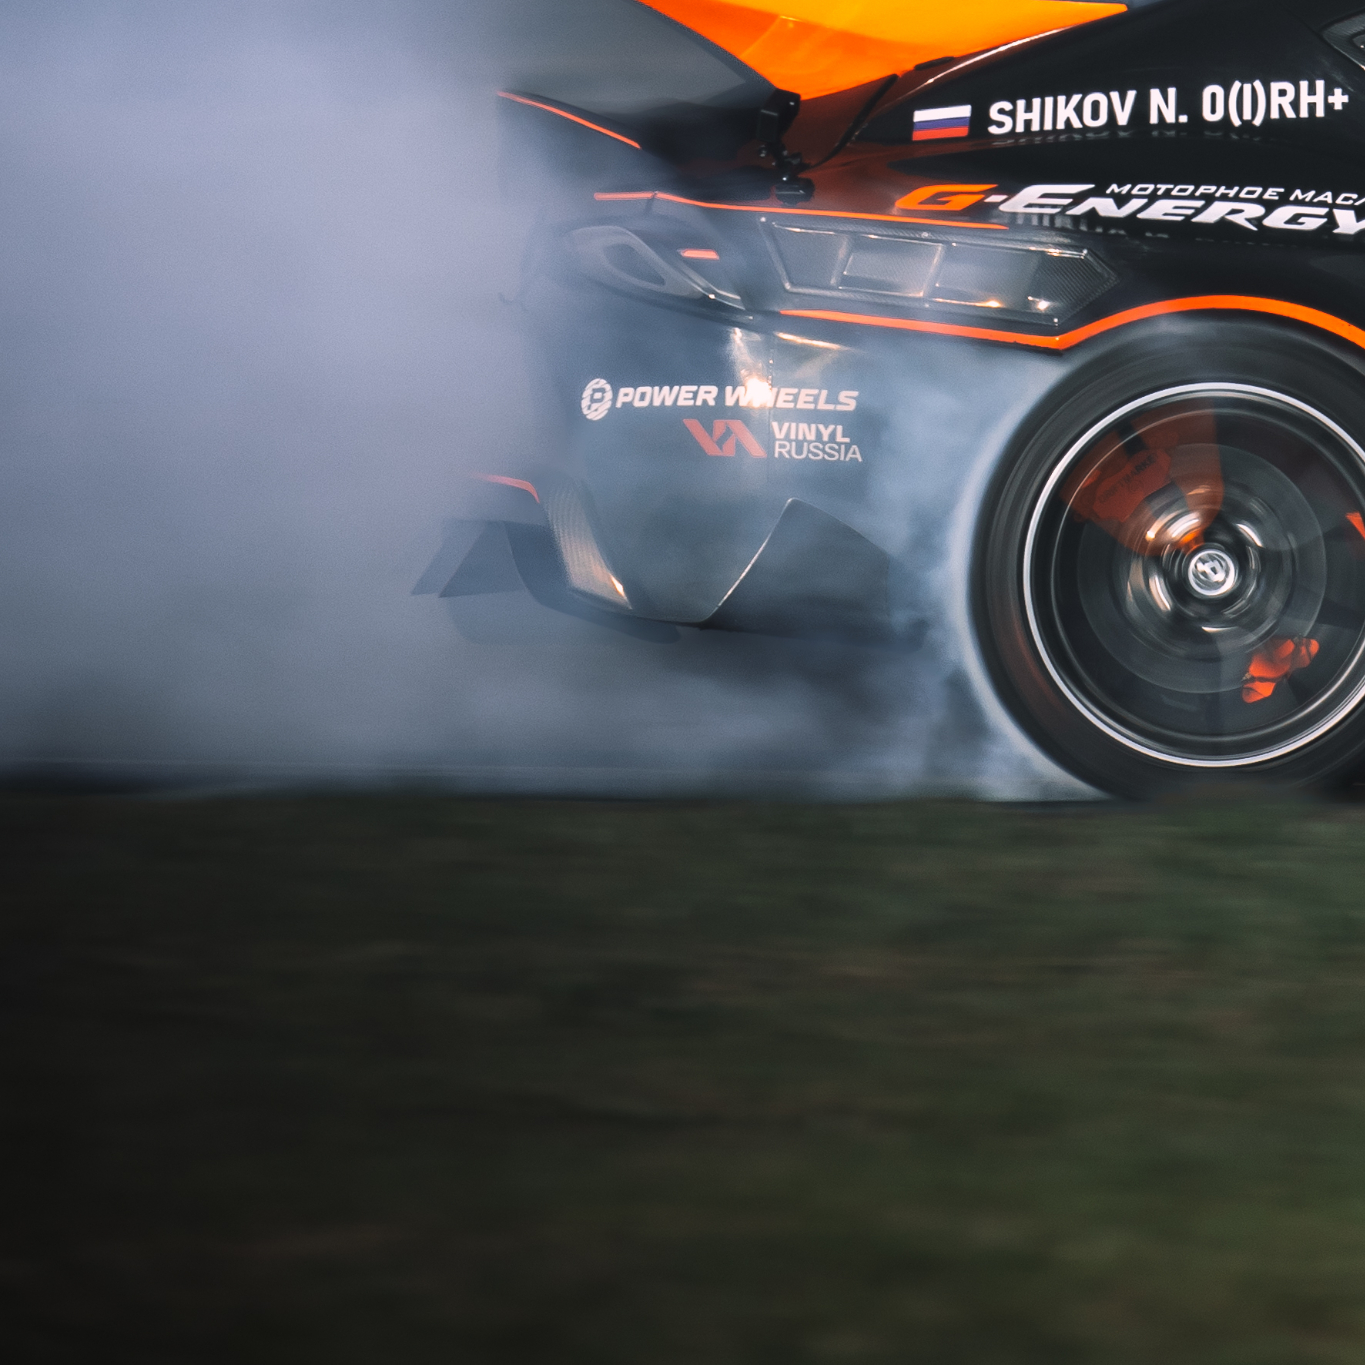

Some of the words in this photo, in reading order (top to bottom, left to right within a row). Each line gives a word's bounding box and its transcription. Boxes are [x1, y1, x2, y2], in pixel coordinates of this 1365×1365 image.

[987, 89, 1137, 135] SHIKOV
[1149, 86, 1188, 125] N.
[615, 386, 719, 408] POWER
[772, 421, 850, 443] VINYL
[774, 441, 863, 462] RUSSIA
